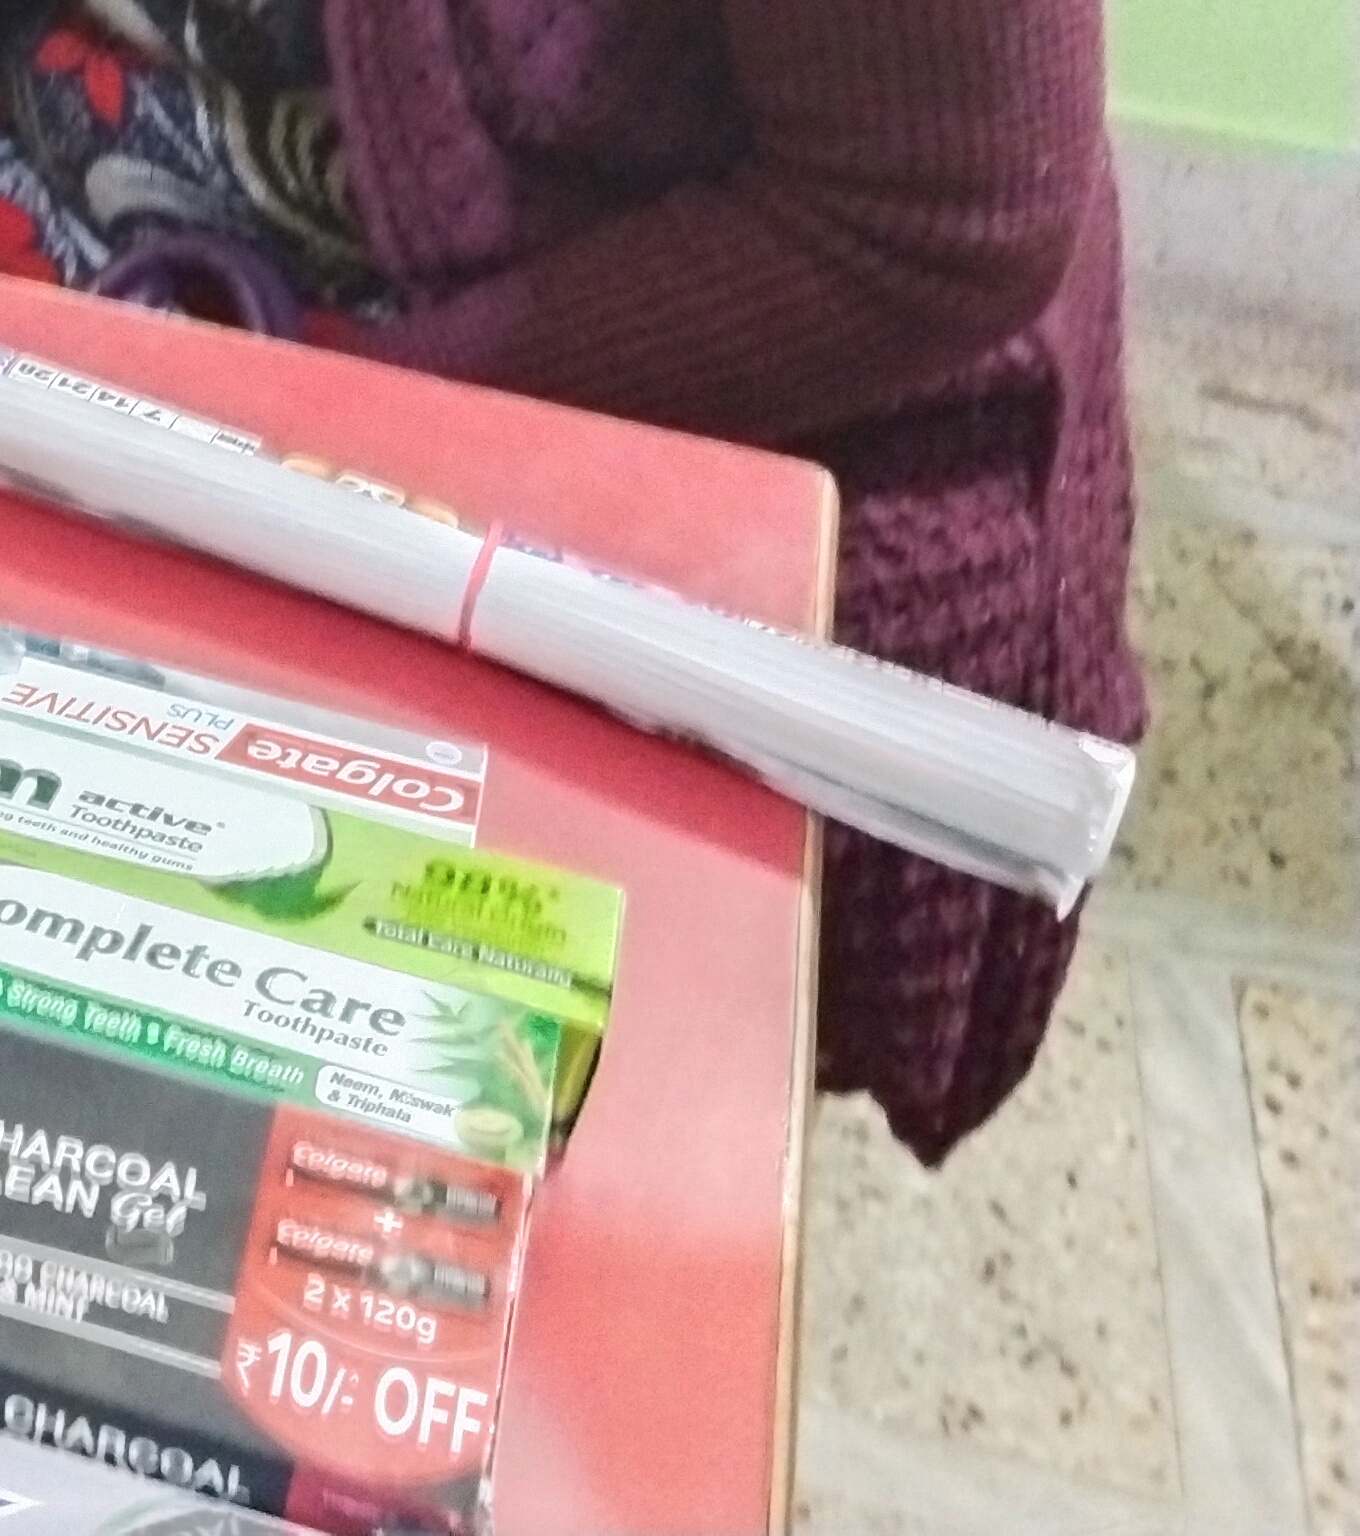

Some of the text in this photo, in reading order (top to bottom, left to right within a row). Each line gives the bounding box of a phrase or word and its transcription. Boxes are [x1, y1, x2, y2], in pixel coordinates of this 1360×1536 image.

[2, 683, 221, 756] SENSITIVE
[168, 702, 234, 732] PLUS
[246, 738, 465, 813] Colgate
[70, 804, 203, 854] Toothpaste
[78, 789, 213, 837] active
[17, 815, 58, 833] teeth
[60, 827, 90, 842] and
[91, 834, 149, 861] healthy
[152, 853, 194, 872] gums
[243, 999, 390, 1058] Toothpaste
[254, 966, 407, 1038] Care
[6, 979, 78, 1026] Strong
[83, 999, 142, 1044] Teeth
[163, 1028, 226, 1069] Fresh
[230, 1048, 305, 1086] Breath
[326, 1088, 413, 1125] & Triphala
[329, 1070, 456, 1119] Neem, Miswak
[292, 1140, 388, 1188] Colgate
[110, 1190, 188, 1238] Gel
[276, 1218, 375, 1264] Colgate
[39, 1260, 169, 1324] CHARCOAL
[302, 1272, 326, 1309] 2
[359, 1293, 438, 1345] 120g
[374, 1364, 489, 1456] OFF
[3, 1393, 251, 1504] CHARCOAL
